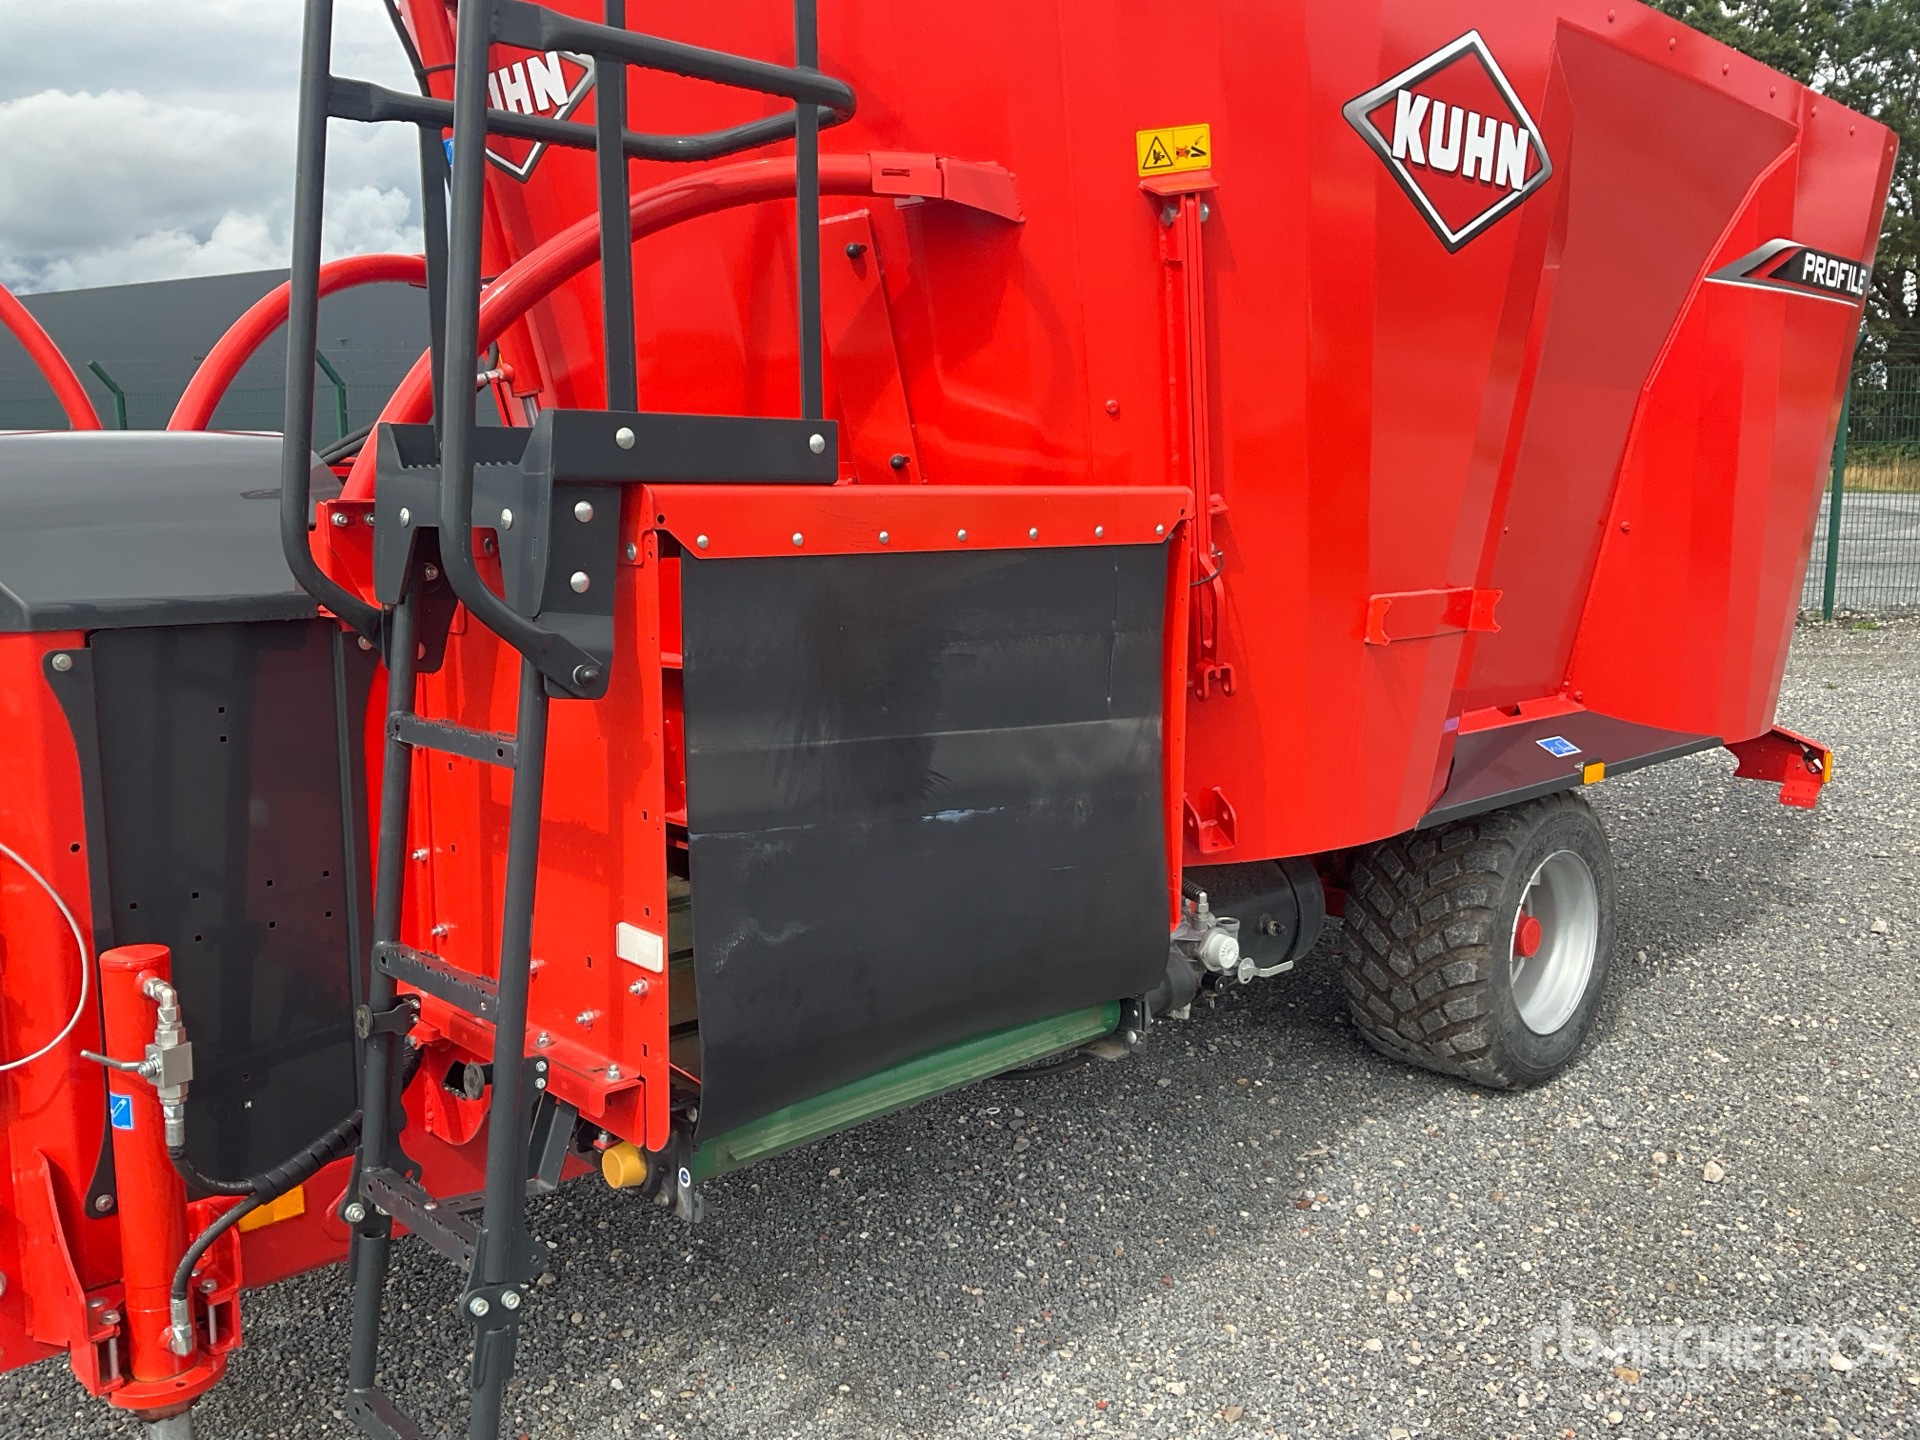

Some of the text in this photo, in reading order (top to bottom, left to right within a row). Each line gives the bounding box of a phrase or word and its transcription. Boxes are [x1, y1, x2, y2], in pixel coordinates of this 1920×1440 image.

[488, 51, 569, 114] HN
[1391, 88, 1530, 191] KUHN
[1802, 252, 1867, 295] PROFILE
